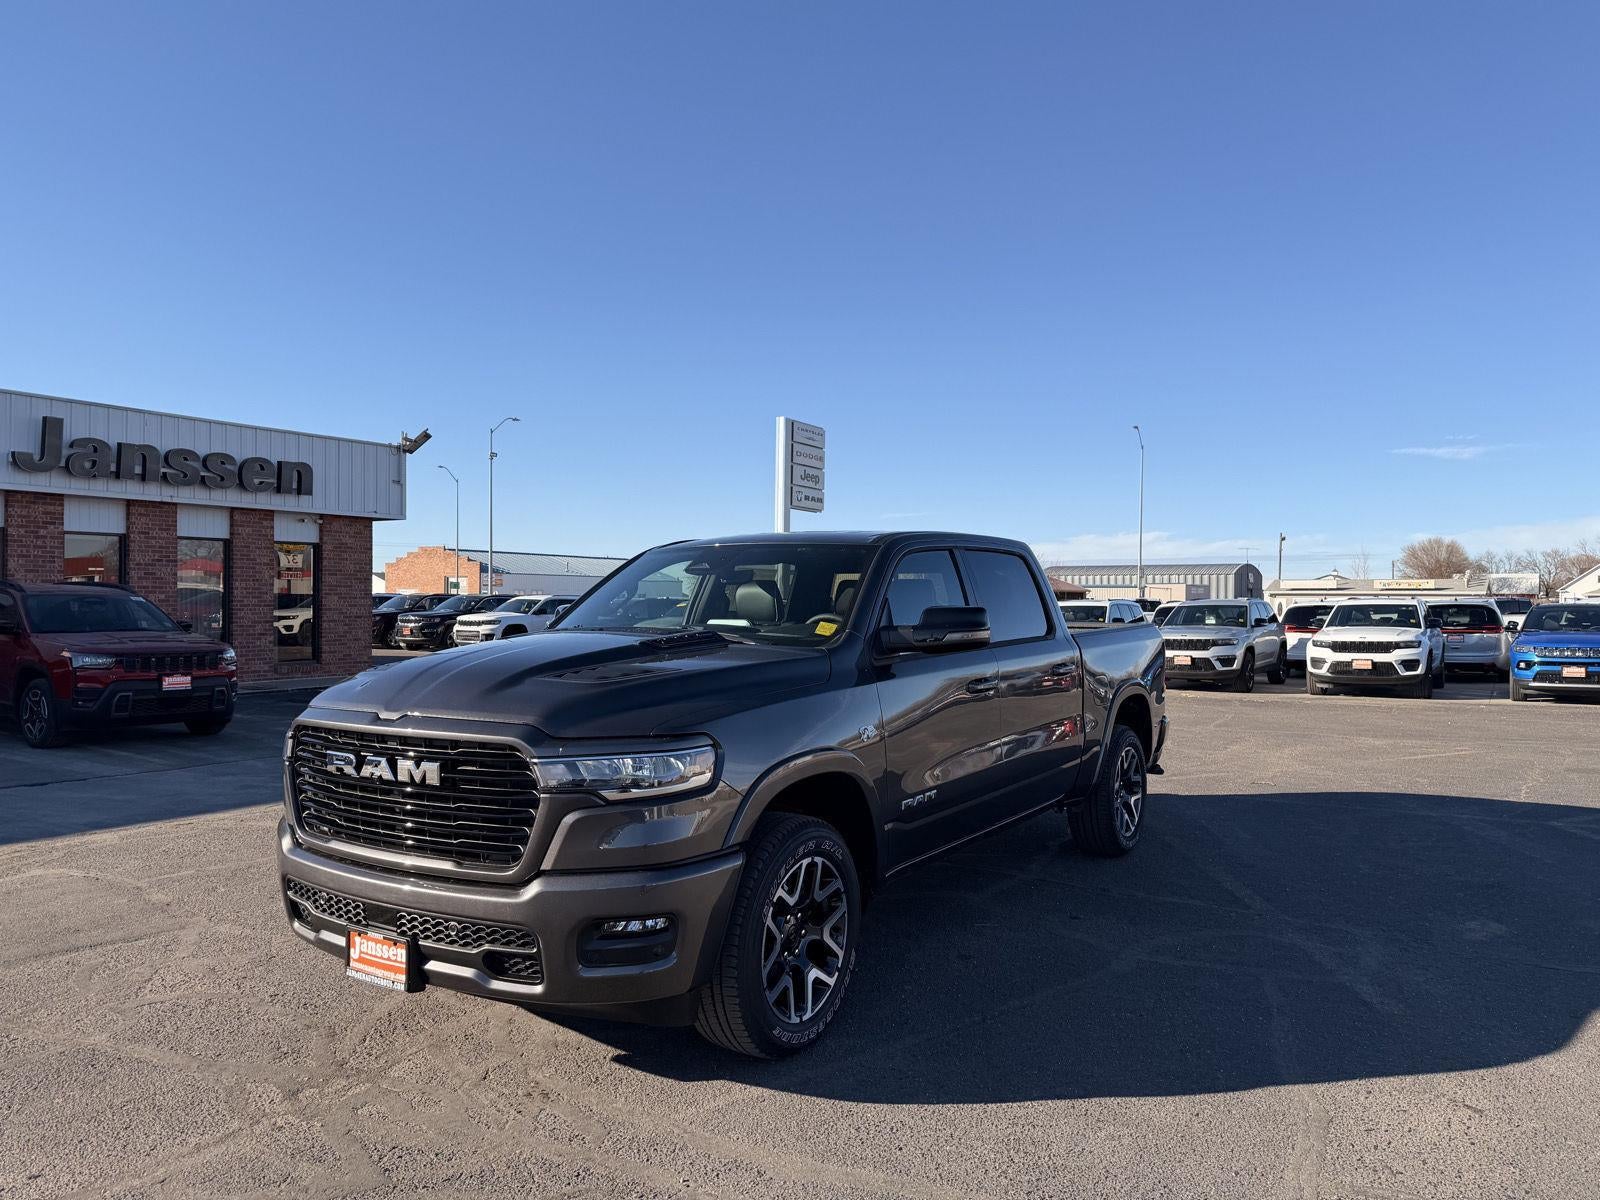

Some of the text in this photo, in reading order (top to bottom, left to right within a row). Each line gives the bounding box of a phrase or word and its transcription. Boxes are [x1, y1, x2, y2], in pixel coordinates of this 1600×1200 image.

[797, 426, 824, 437] CHRYSLER
[10, 416, 314, 496] Janssen
[796, 450, 824, 462] DODGE
[800, 469, 821, 487] Jeep
[804, 494, 823, 504] RAM
[326, 750, 441, 786] RAM
[901, 789, 938, 811] RAM
[350, 936, 406, 962] Janssen
